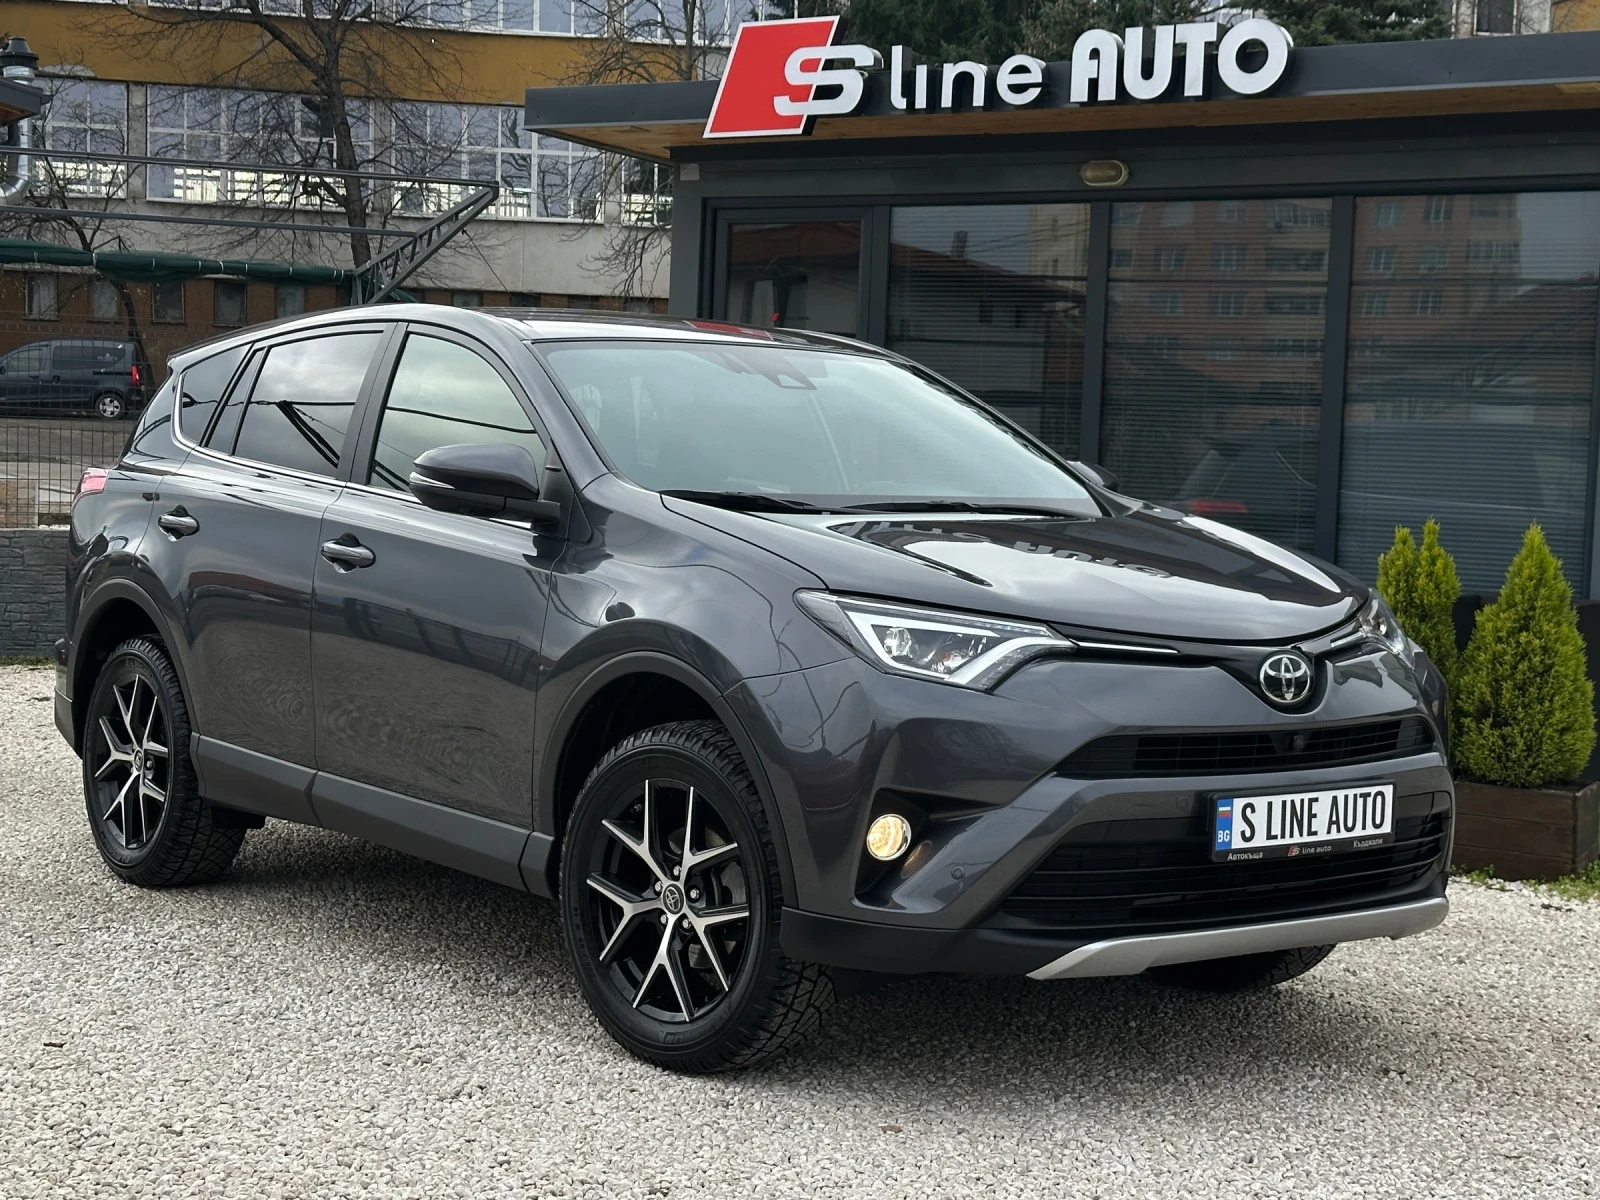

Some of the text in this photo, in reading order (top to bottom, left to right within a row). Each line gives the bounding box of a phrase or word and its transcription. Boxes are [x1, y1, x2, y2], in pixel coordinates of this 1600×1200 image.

[773, 18, 1289, 117] S line AUTO
[1240, 790, 1386, 843] S LINE AUTO
[1217, 829, 1230, 842] BG
[1316, 845, 1332, 853] auto
[1227, 851, 1263, 861] Автокъща
